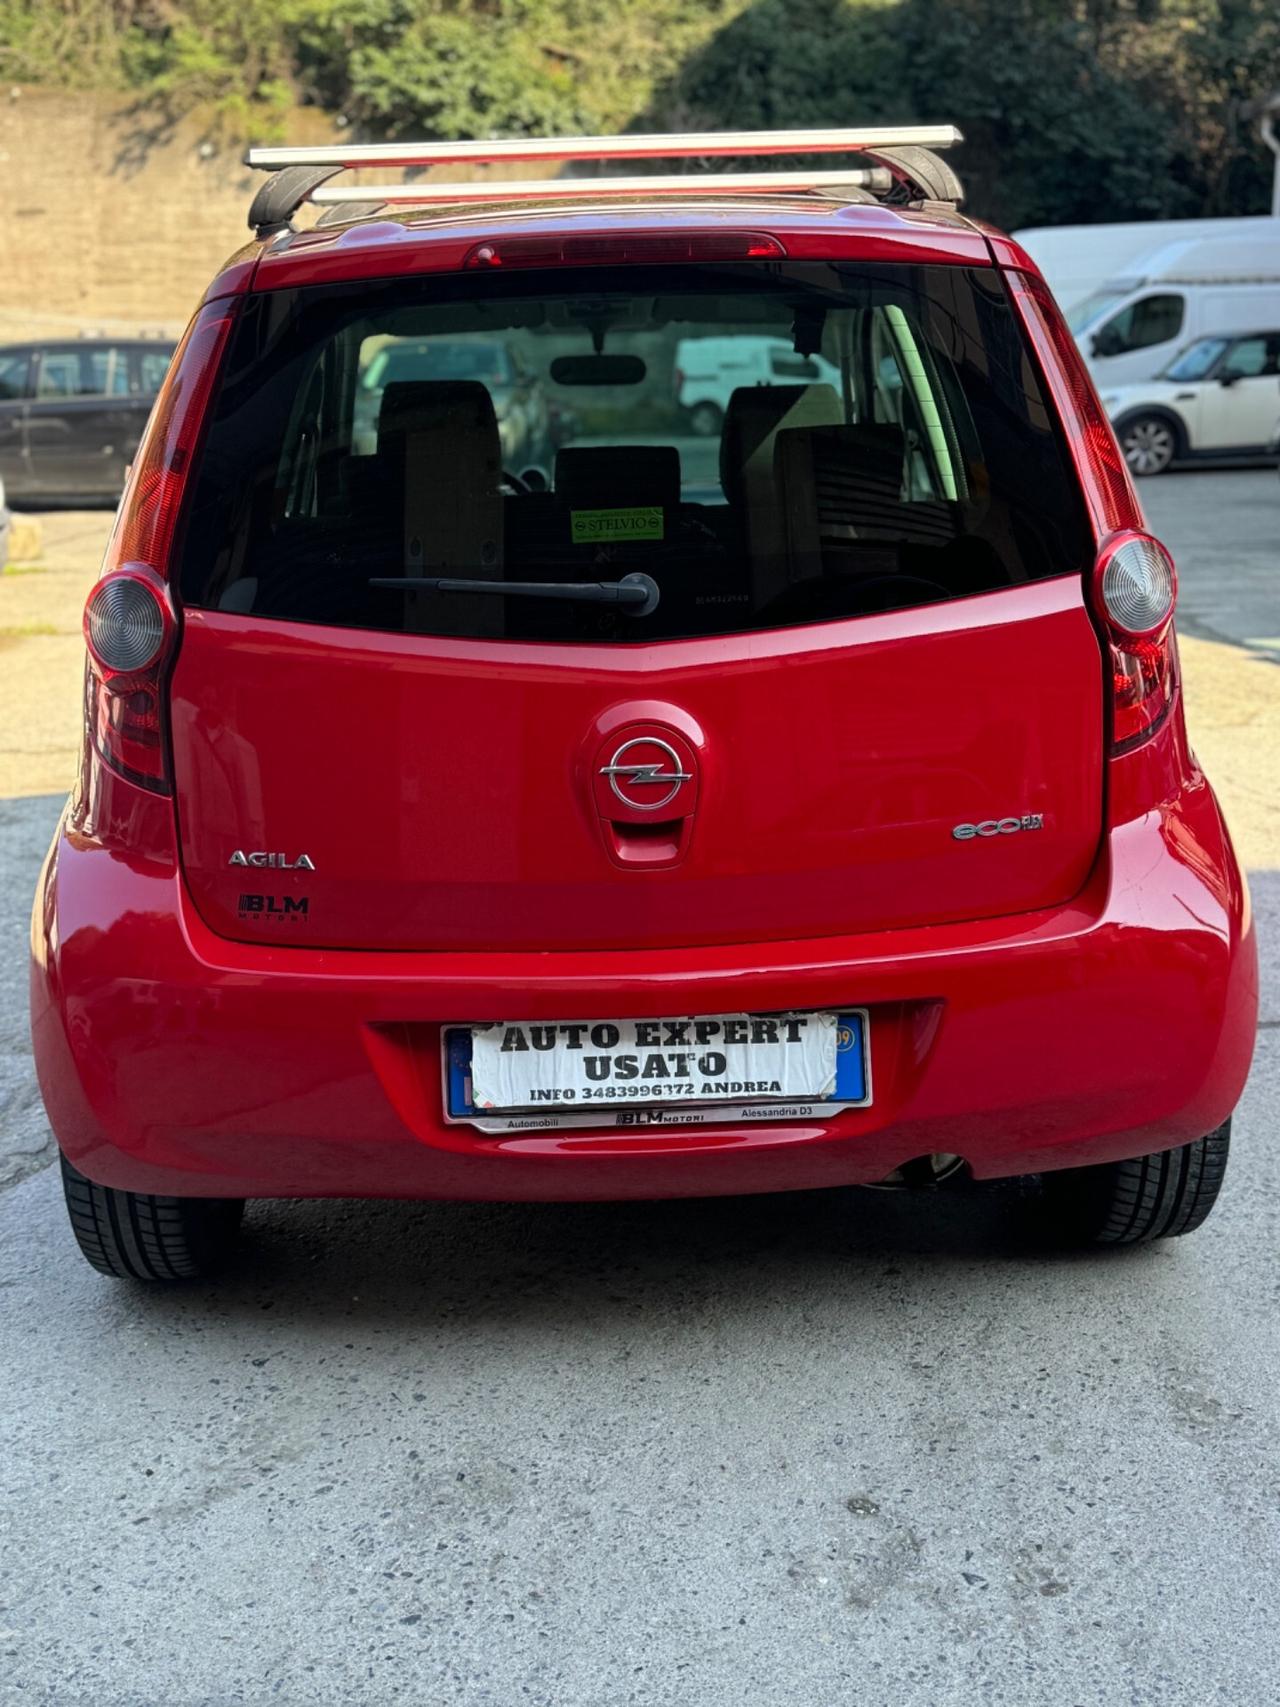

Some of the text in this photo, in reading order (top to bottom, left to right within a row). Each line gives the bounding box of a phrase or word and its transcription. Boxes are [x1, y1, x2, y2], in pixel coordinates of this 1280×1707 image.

[587, 517, 647, 531] STELVIO
[228, 850, 315, 870] AGILA
[239, 895, 309, 914] BLM
[501, 1019, 808, 1052] AUTO EXPERT
[583, 1052, 727, 1080] USATO
[530, 1080, 782, 1101] INFO 3483996372 ANDREA
[616, 1112, 664, 1125] BLM
[741, 1105, 813, 1118] Alessandria D3
[507, 1118, 559, 1129] Automobili
